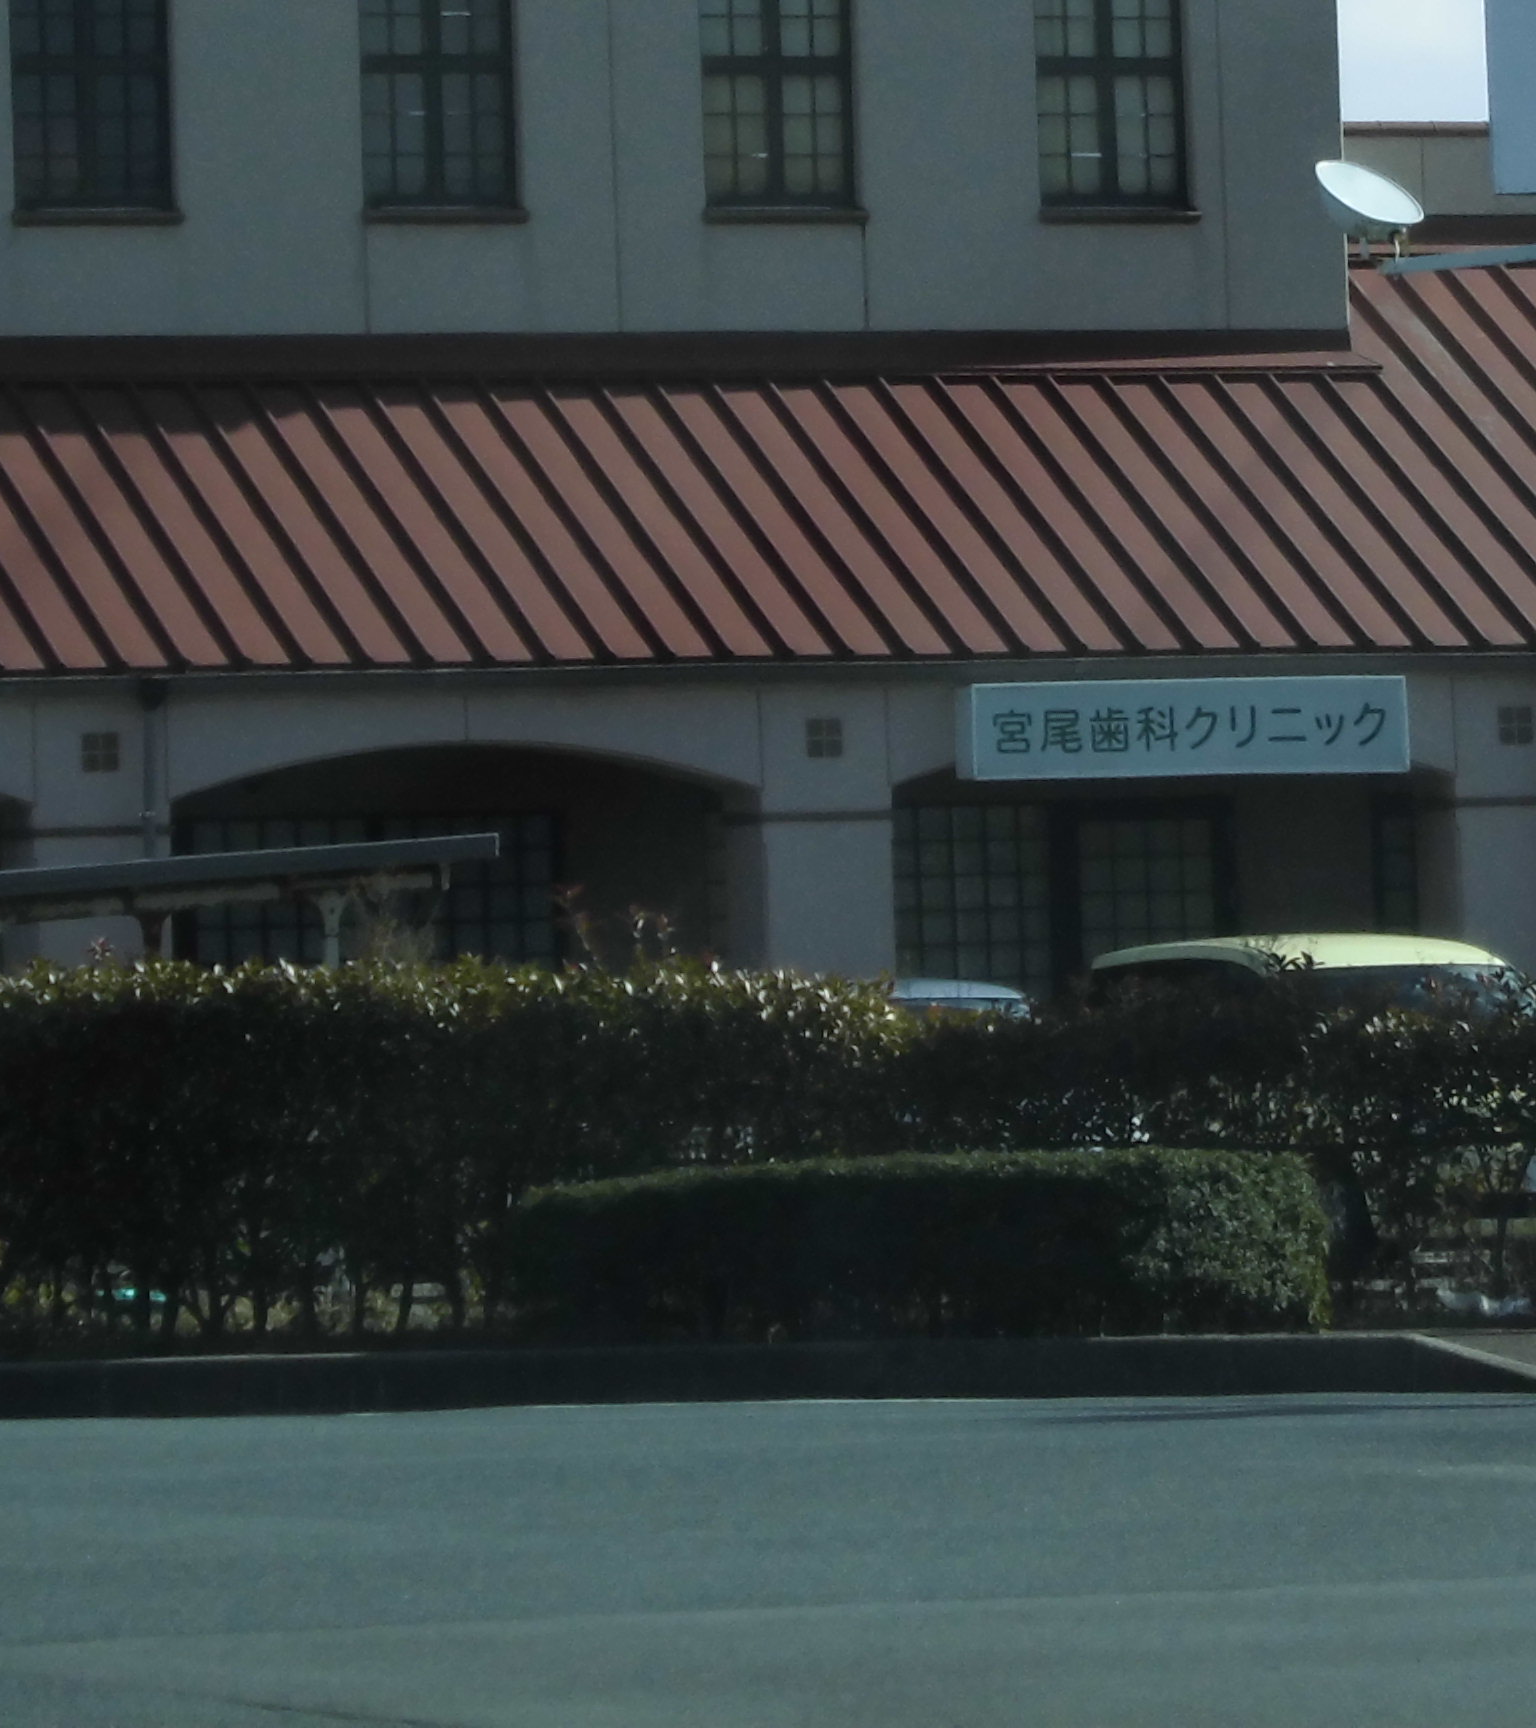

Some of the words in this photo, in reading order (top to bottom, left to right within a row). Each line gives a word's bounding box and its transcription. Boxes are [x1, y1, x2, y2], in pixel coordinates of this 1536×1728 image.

[992, 702, 1387, 754] 宮尾歯科クリニック
